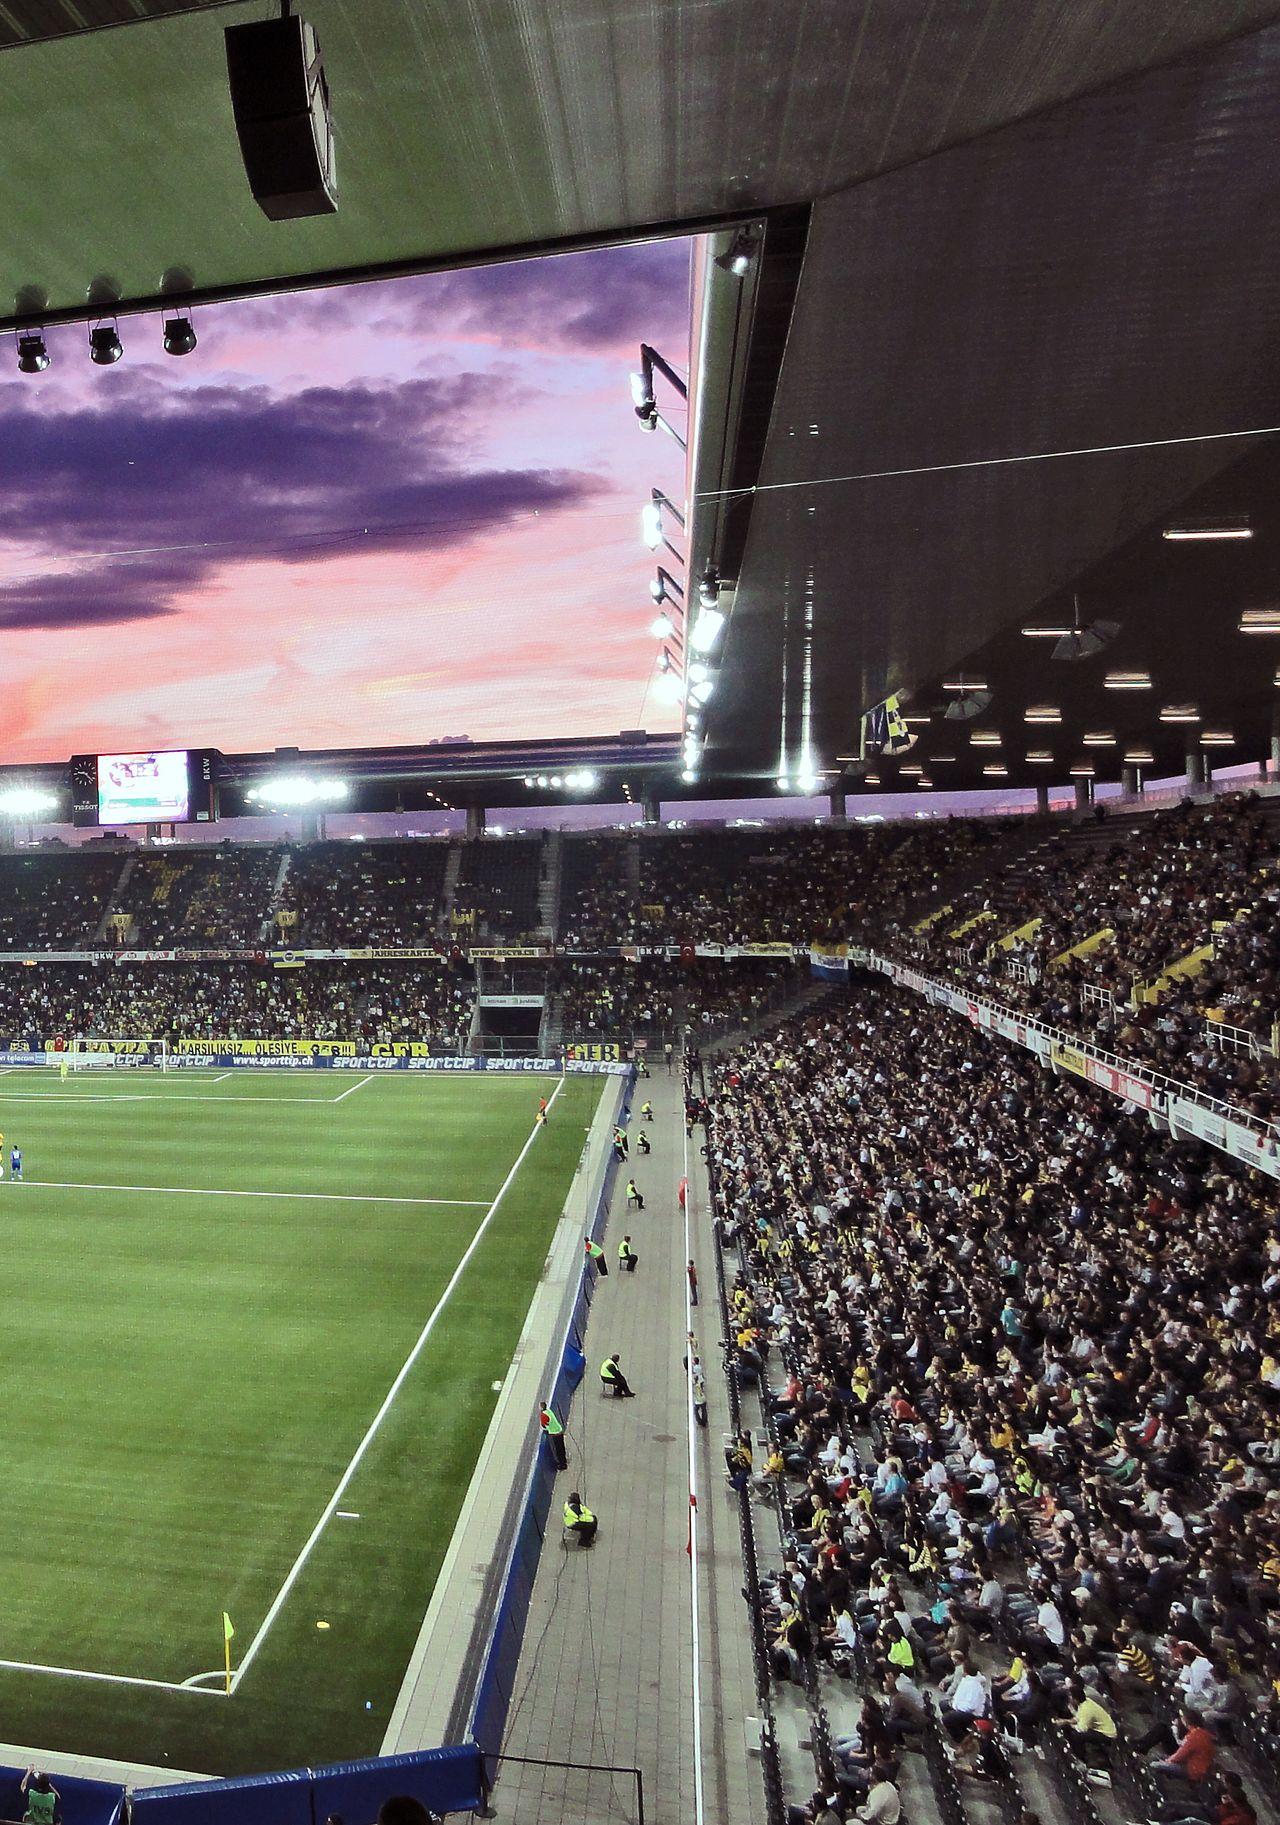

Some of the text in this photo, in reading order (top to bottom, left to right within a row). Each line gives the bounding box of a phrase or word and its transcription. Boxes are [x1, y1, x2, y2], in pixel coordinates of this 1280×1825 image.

[203, 758, 211, 780] BKW
[95, 952, 114, 960] BKW
[640, 947, 662, 955] BKW
[232, 1055, 314, 1067] www.sporttip.ch
